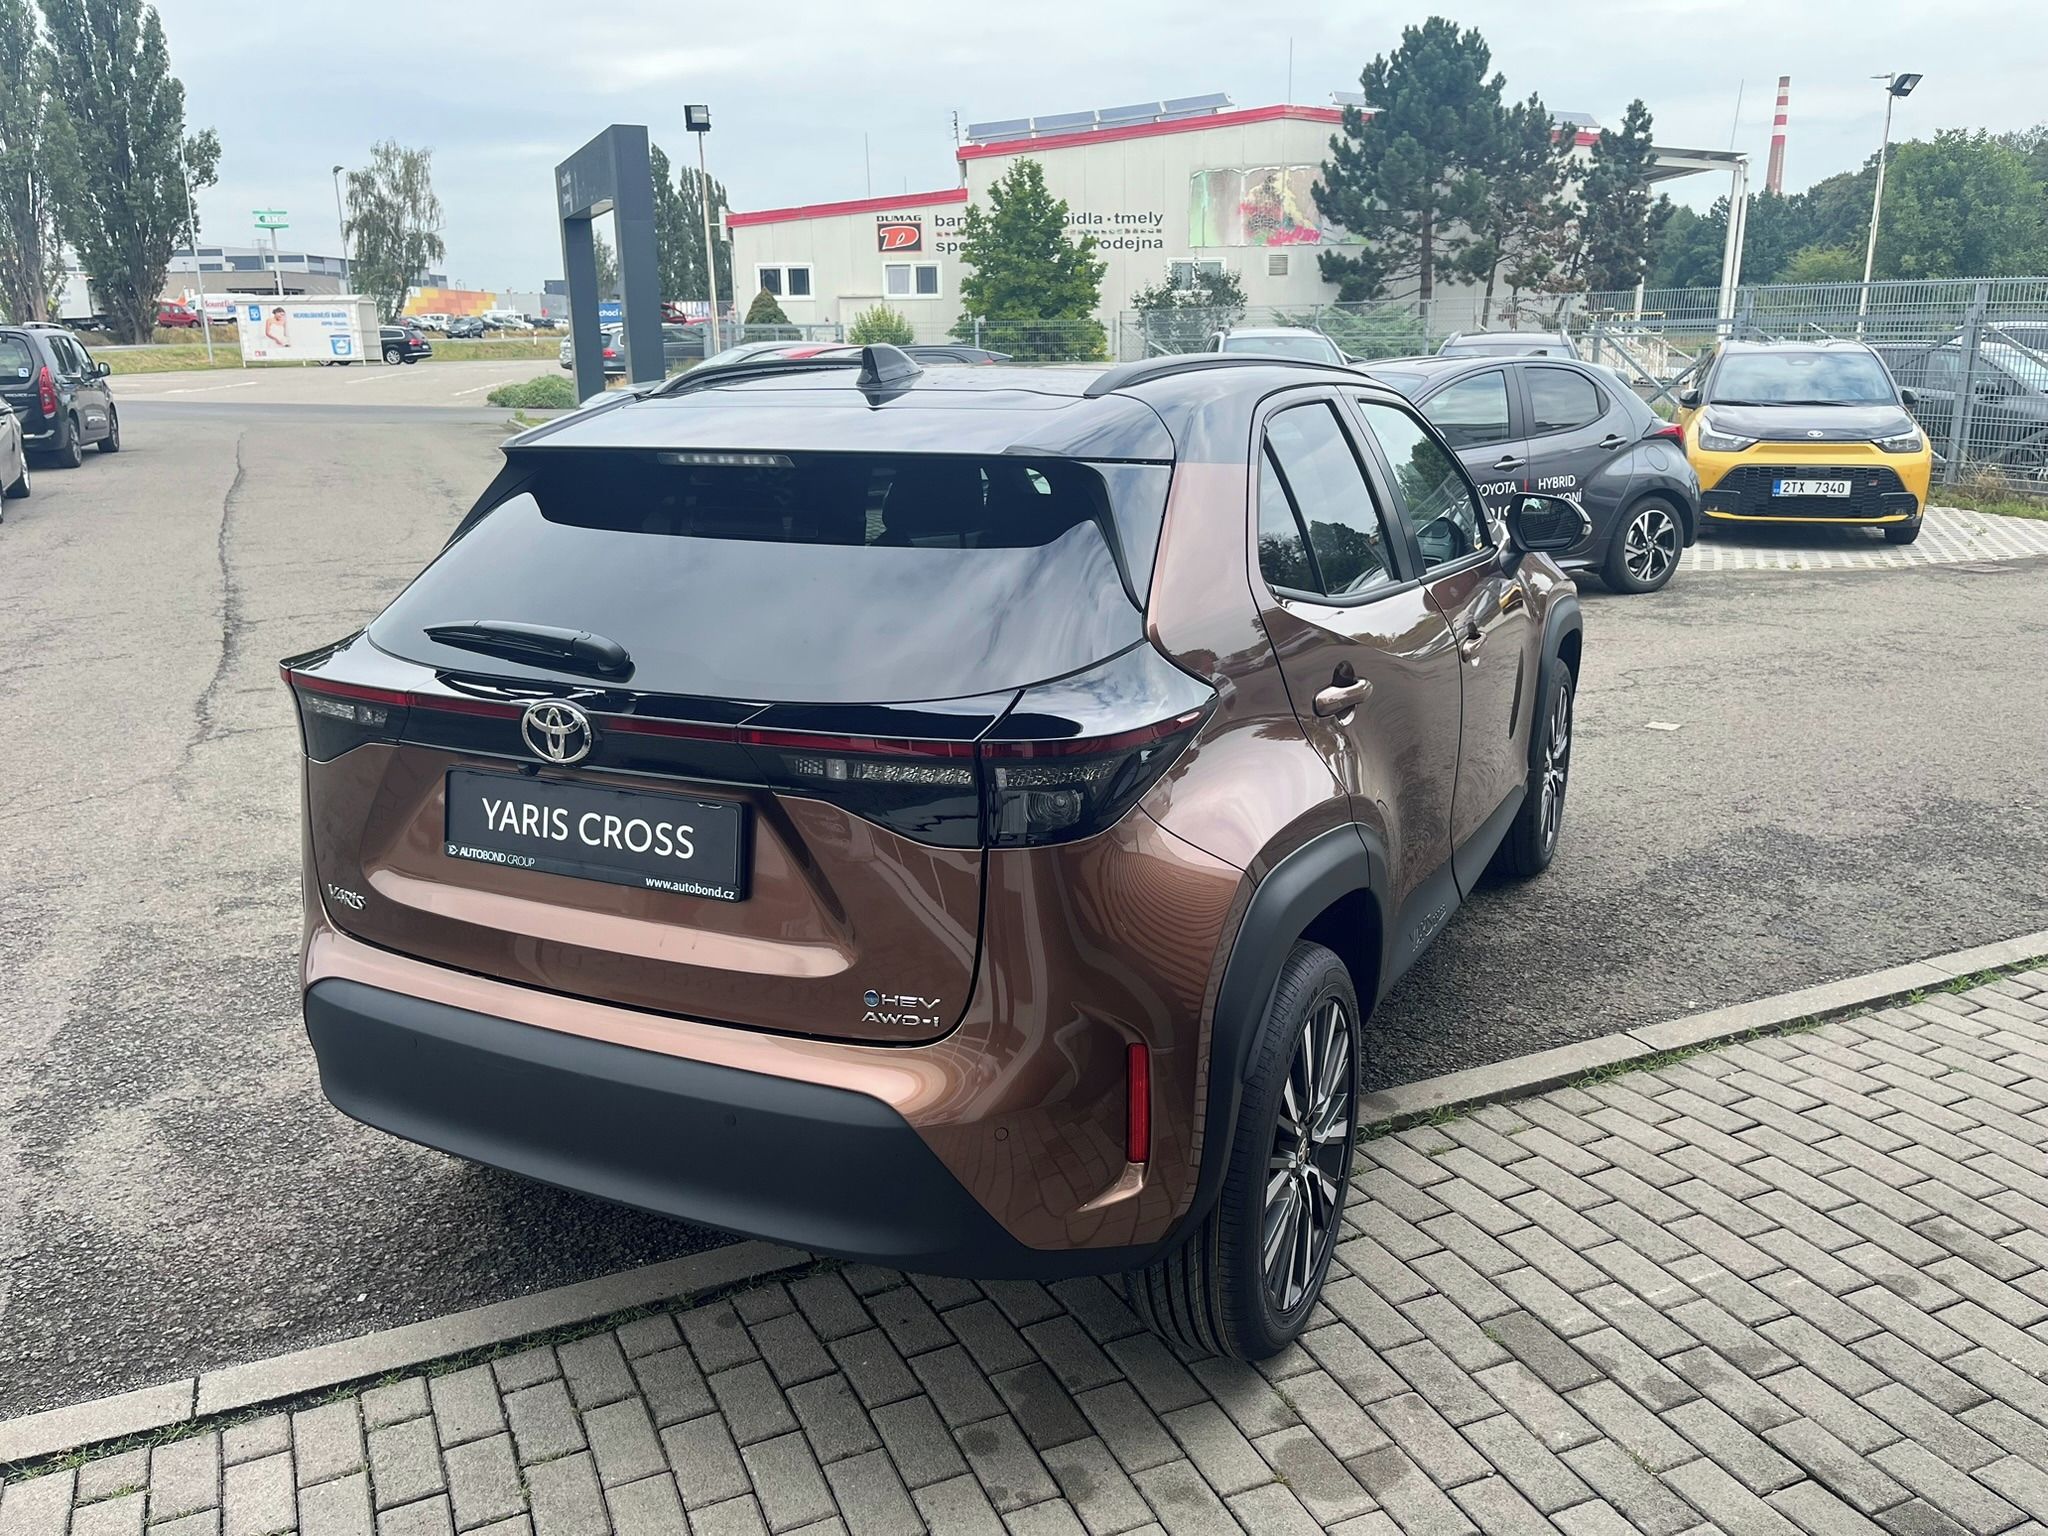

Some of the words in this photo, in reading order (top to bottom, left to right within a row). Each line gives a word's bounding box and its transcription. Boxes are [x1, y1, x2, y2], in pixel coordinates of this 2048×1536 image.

[876, 214, 922, 222] DUMAG
[1114, 211, 1164, 226] tmely
[1092, 236, 1164, 252] odejna
[1477, 481, 1517, 497] OYOTA
[1538, 474, 1576, 490] HYBRID
[1783, 481, 1805, 493] 2TX
[1814, 481, 1845, 494] 7340
[482, 797, 569, 841] YARIS
[578, 812, 695, 859] CROSS
[459, 847, 506, 863] AUTOBOND
[507, 854, 535, 868] GROUP
[645, 877, 735, 900] www.autobond.cz
[881, 993, 941, 1010] HEV
